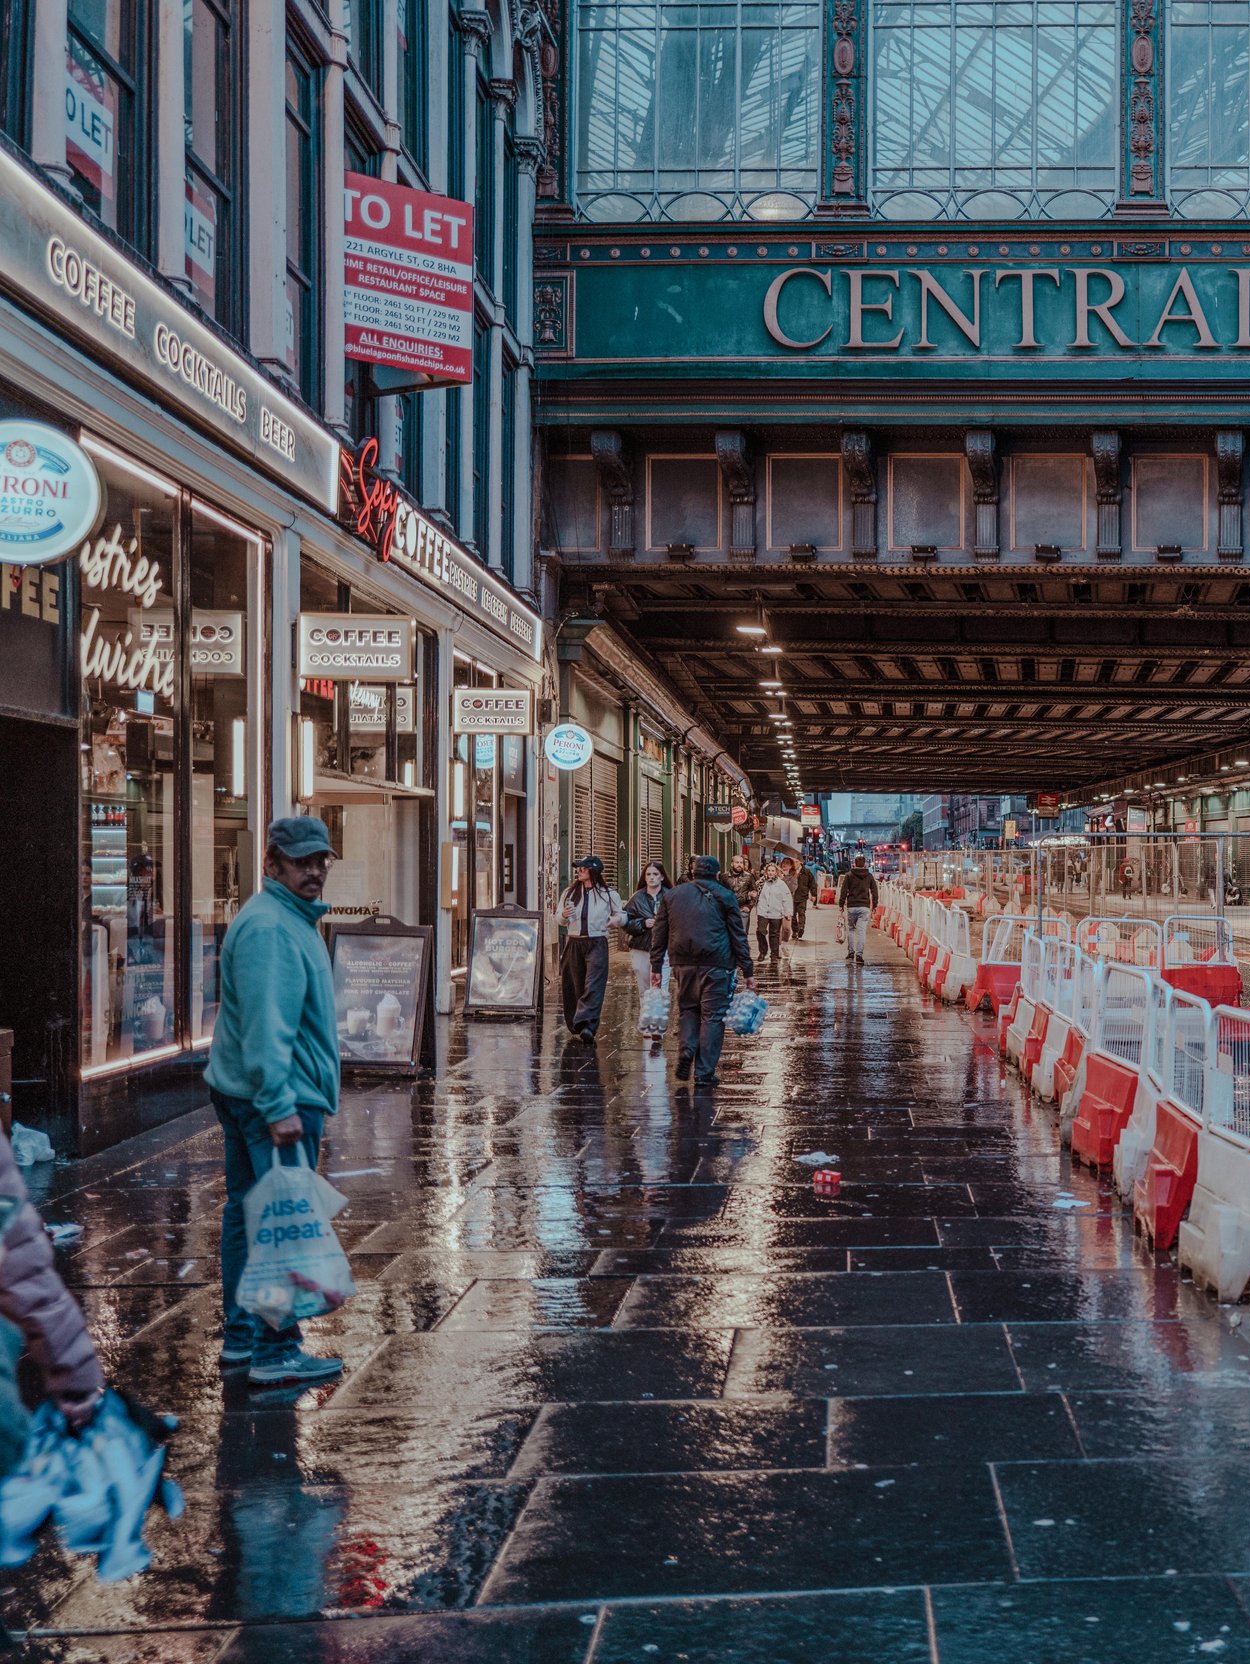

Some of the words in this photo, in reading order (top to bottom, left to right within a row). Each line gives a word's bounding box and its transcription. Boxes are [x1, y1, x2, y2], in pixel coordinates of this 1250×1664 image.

[66, 88, 76, 121] O
[81, 102, 111, 153] LET
[344, 188, 391, 230] TO
[404, 203, 466, 248] LET
[190, 216, 213, 259] LET
[346, 240, 364, 252] 221
[367, 245, 404, 261] ARGYLE
[407, 254, 420, 267] ST,
[422, 259, 435, 270] G2
[438, 262, 457, 275] 8HA
[358, 274, 417, 295] RESTAURANT
[419, 288, 446, 302] SPACE
[367, 263, 467, 294] RETAIL/OFFICE/LEISURE
[353, 292, 382, 305] FLOOR:
[384, 298, 402, 309] 2461
[404, 303, 415, 312] SQ
[416, 306, 426, 315] FT
[433, 310, 447, 320] 229
[448, 313, 460, 323] M2
[354, 302, 383, 315] FLOOR:
[385, 309, 403, 320] 2461
[405, 313, 416, 323] SQ
[417, 316, 427, 325] FT
[434, 319, 447, 330] 229
[449, 323, 461, 333] M2
[354, 313, 382, 326] FLOOR:
[384, 319, 402, 330] 2461
[404, 324, 415, 333] SQ
[417, 326, 426, 335] FT
[433, 329, 447, 340] 229
[448, 333, 460, 343] M2
[360, 332, 380, 346] ALL
[48, 236, 136, 339] COFFEE
[155, 322, 247, 424] COCKTAILS
[261, 407, 296, 463] BEER
[1, 475, 72, 499] RONI
[357, 437, 399, 562] Sexy
[394, 503, 451, 585] COFFEE
[449, 561, 478, 602] PASTRIES
[510, 611, 533, 644] DESSERTS
[308, 627, 401, 647] COFFEE
[308, 653, 401, 667] COCKTAILS
[460, 698, 525, 710] COFFEE
[460, 716, 525, 726] COCKTAILS
[553, 739, 584, 750] PERONI
[346, 959, 382, 967] ALCOHOLIC
[254, 1220, 331, 1248] epeat.
